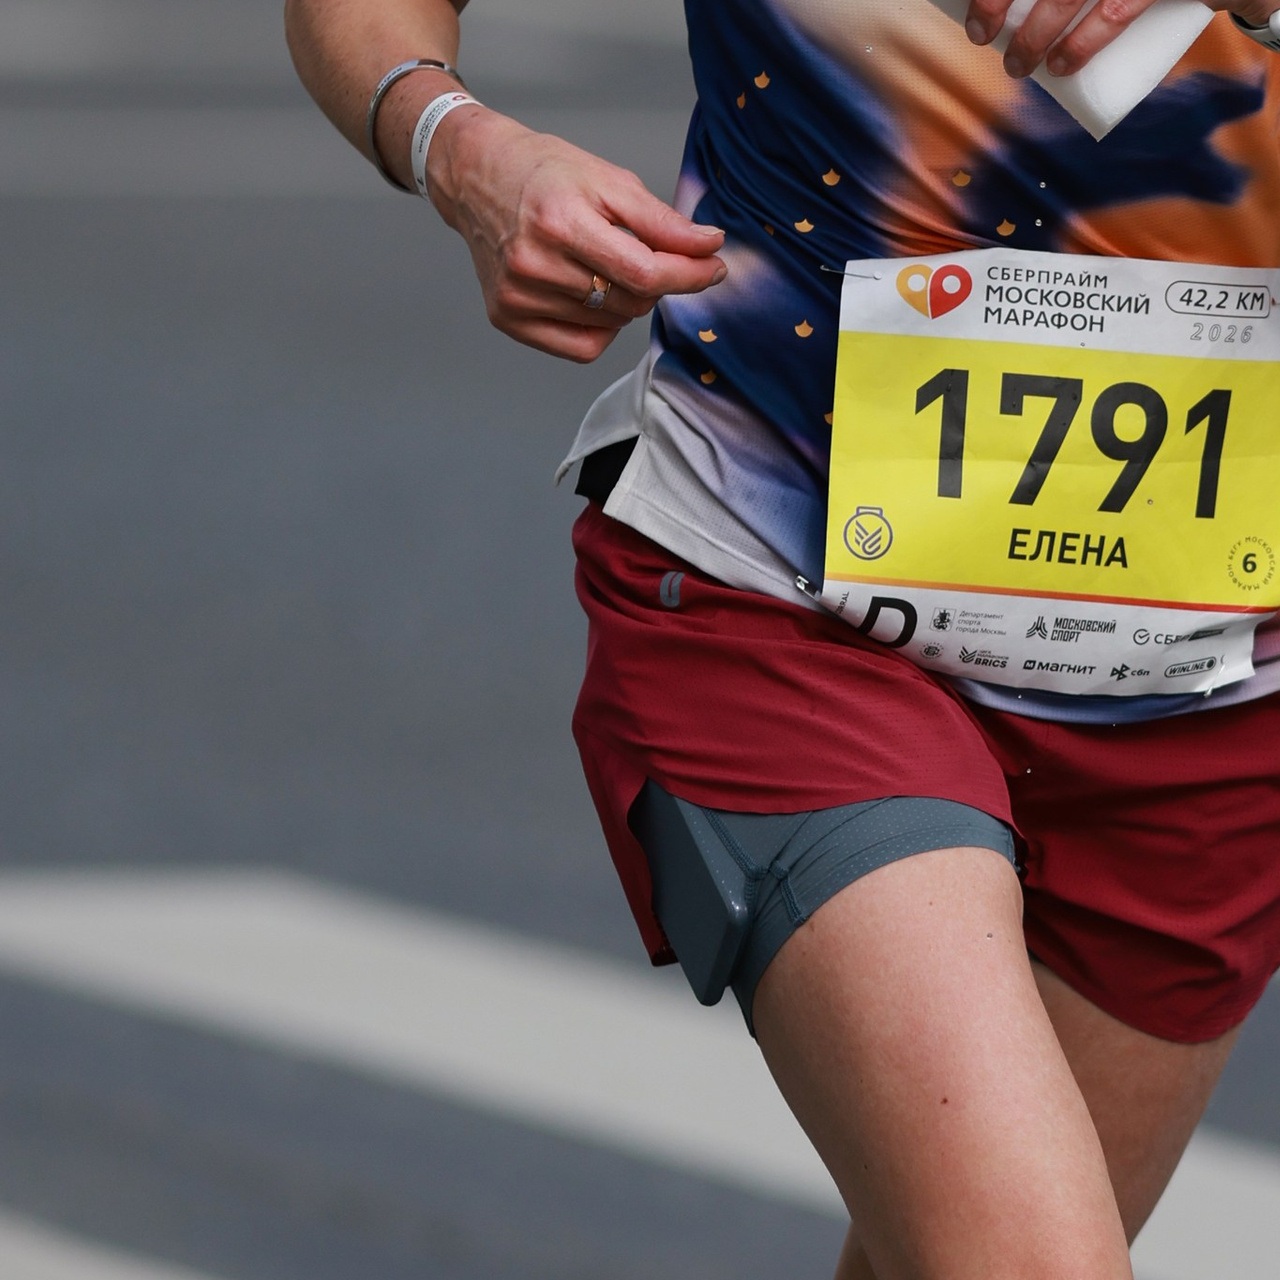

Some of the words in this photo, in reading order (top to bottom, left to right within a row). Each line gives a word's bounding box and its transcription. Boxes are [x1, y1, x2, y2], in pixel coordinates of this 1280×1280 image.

[986, 266, 1109, 289] СБЕРПРАЙМ
[984, 285, 1151, 315] МОСКОВСКИЙ
[1178, 288, 1230, 311] 42,2
[1236, 291, 1266, 312] КМ
[983, 307, 1106, 333] МАРАФОН
[1190, 322, 1255, 344] 2026
[915, 367, 1232, 519] 1791
[1007, 528, 1129, 569] ЕЛЕНА
[1242, 553, 1257, 573] 6
[1244, 536, 1275, 585] МОСКОВСКИЙ
[1227, 564, 1260, 591] МАРАФОН
[858, 596, 918, 648] D
[959, 610, 1004, 620] Департамент
[1053, 617, 1117, 634] МОСКОВСКИЙ
[956, 626, 979, 634] города
[980, 627, 1007, 636] Москвы
[1050, 630, 1082, 643] СПОРТ
[974, 657, 1008, 668] BRICS
[1037, 662, 1096, 676] магнит
[1131, 668, 1150, 676] сбп
[1168, 661, 1206, 675] WINLINE
